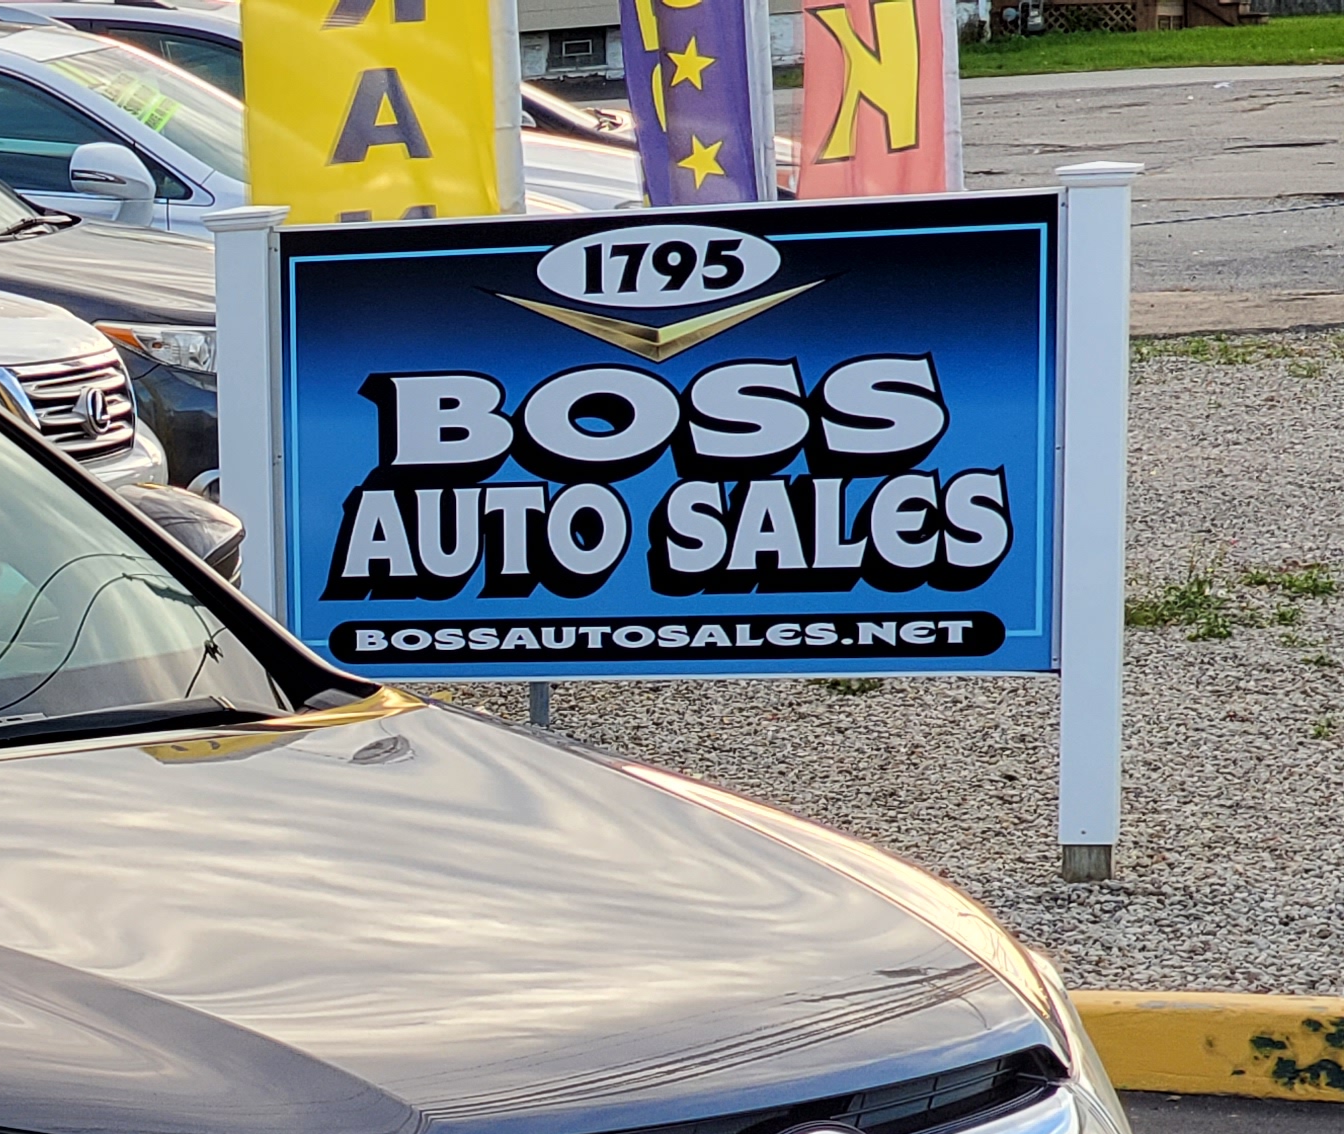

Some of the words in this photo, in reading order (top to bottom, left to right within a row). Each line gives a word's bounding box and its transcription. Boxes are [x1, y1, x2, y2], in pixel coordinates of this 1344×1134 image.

[582, 237, 746, 296] 1795
[391, 358, 947, 465] BOSS
[340, 482, 629, 578] AUTO
[666, 471, 1010, 575] SALES
[354, 619, 974, 654] BOSSAUTOSALES.NET
